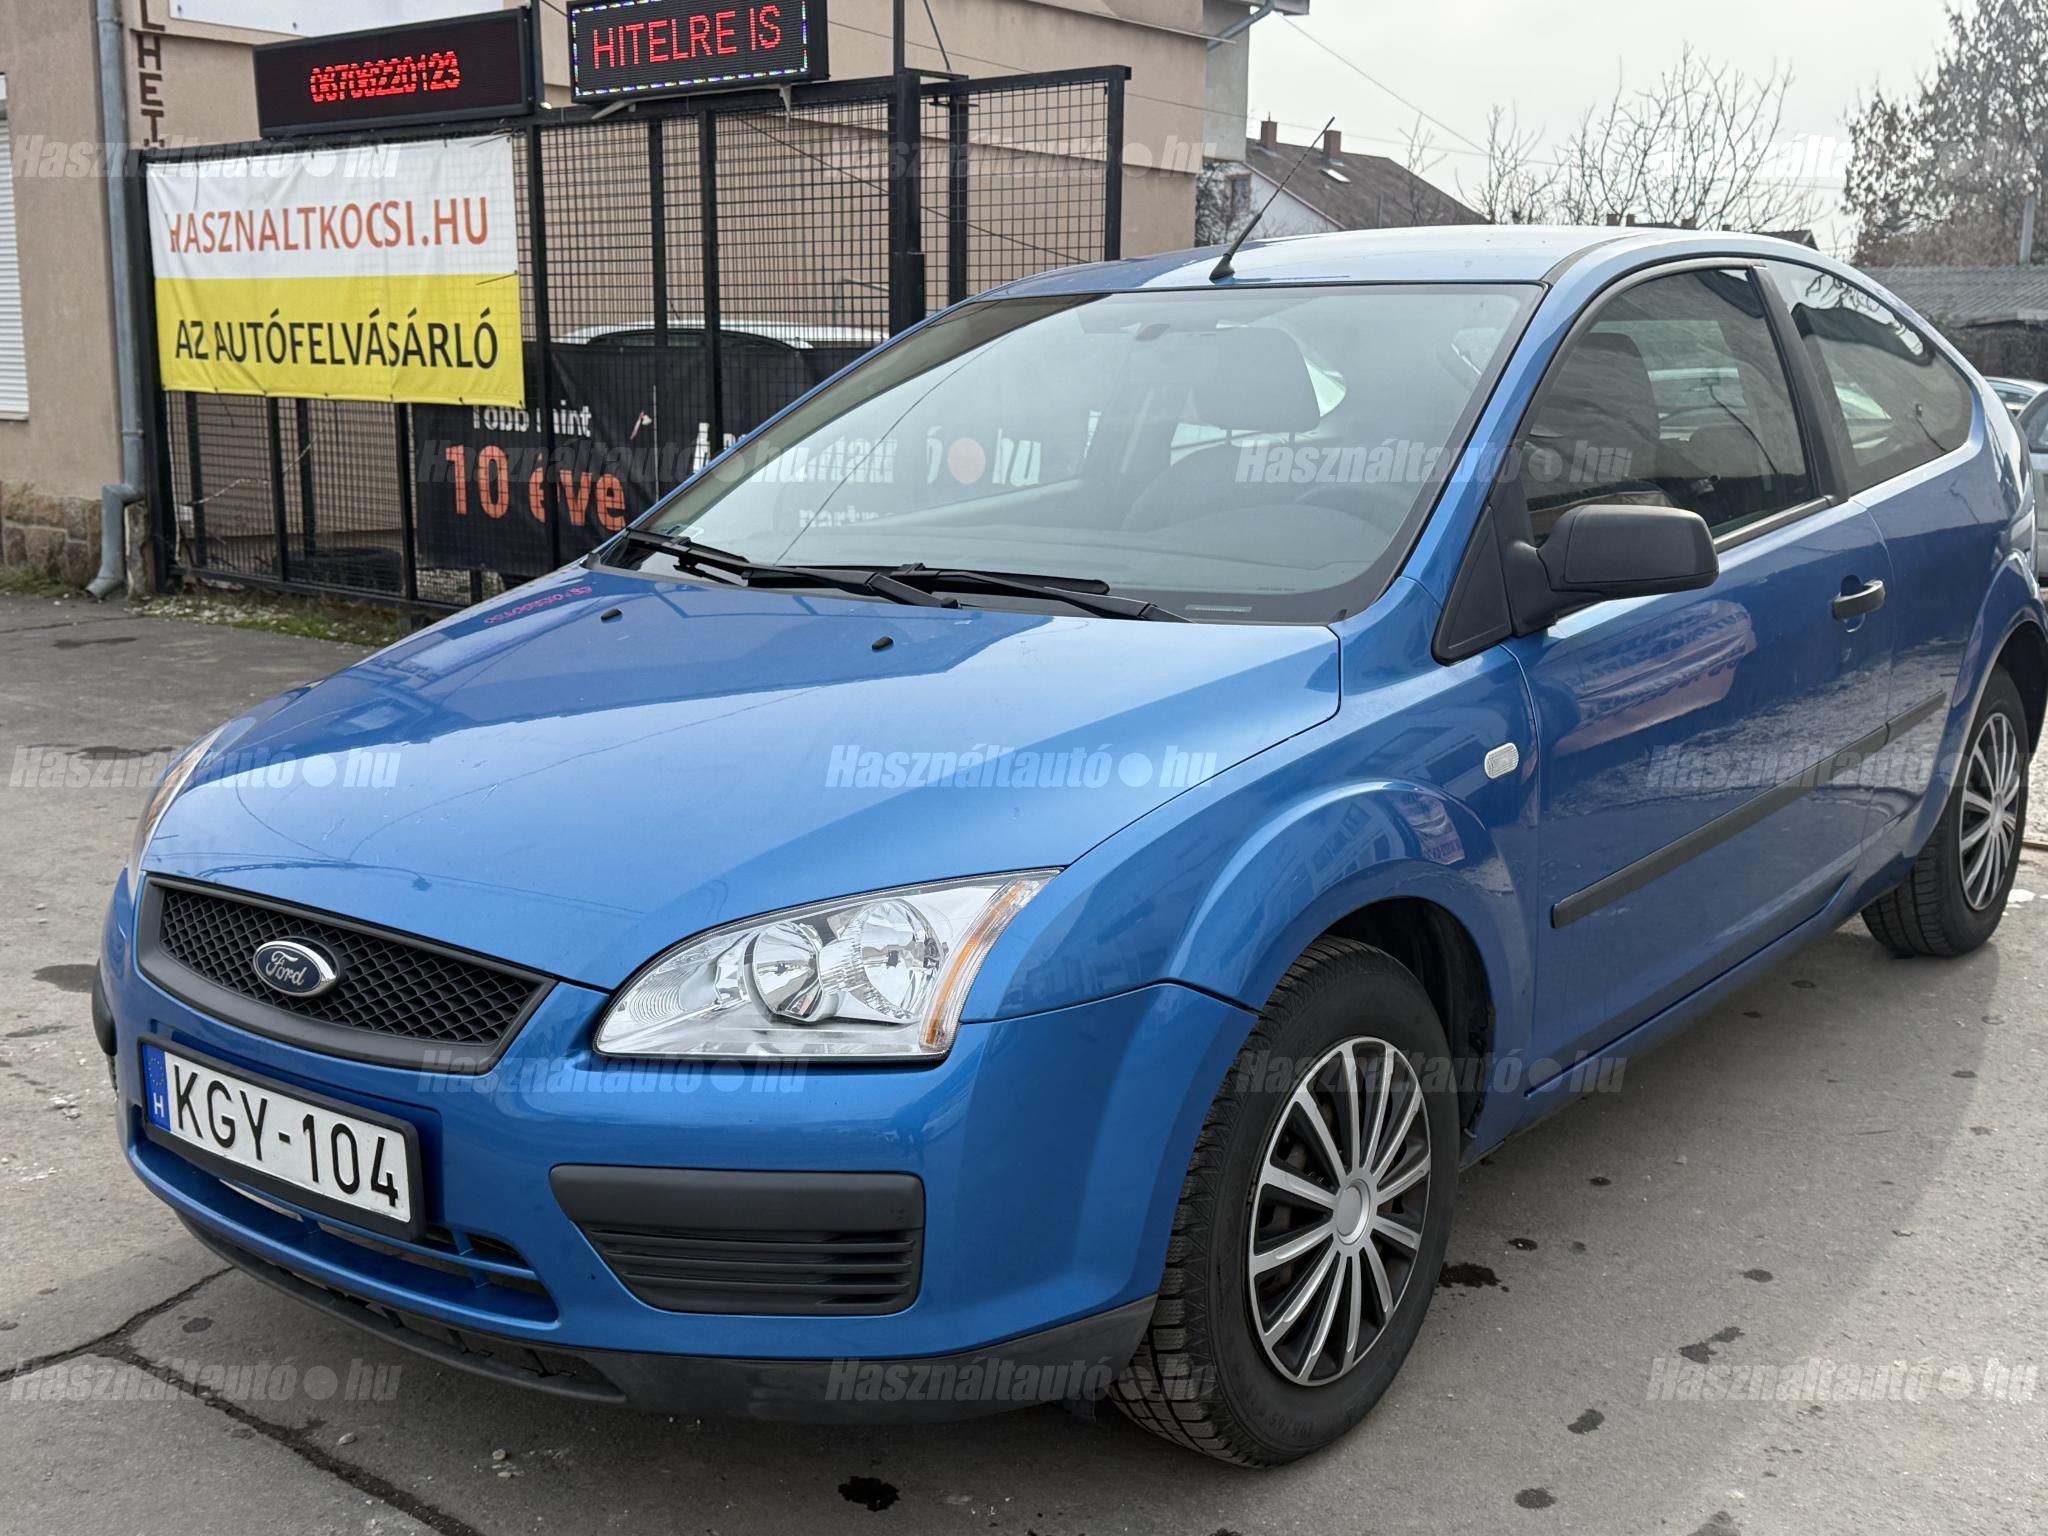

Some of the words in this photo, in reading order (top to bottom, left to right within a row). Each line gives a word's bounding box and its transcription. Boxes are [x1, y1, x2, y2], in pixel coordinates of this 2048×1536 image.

[593, 11, 737, 69] HITELRE
[750, 4, 781, 51] IS
[166, 196, 489, 254] HASZNALTKOCSI.HU
[175, 318, 209, 360] AZ
[214, 307, 498, 369] AUTÓFELVÁSÁRLÓ
[445, 444, 510, 519] 10
[266, 950, 308, 986] Ford
[152, 1092, 165, 1118] H
[173, 1064, 399, 1208] KGY-104
